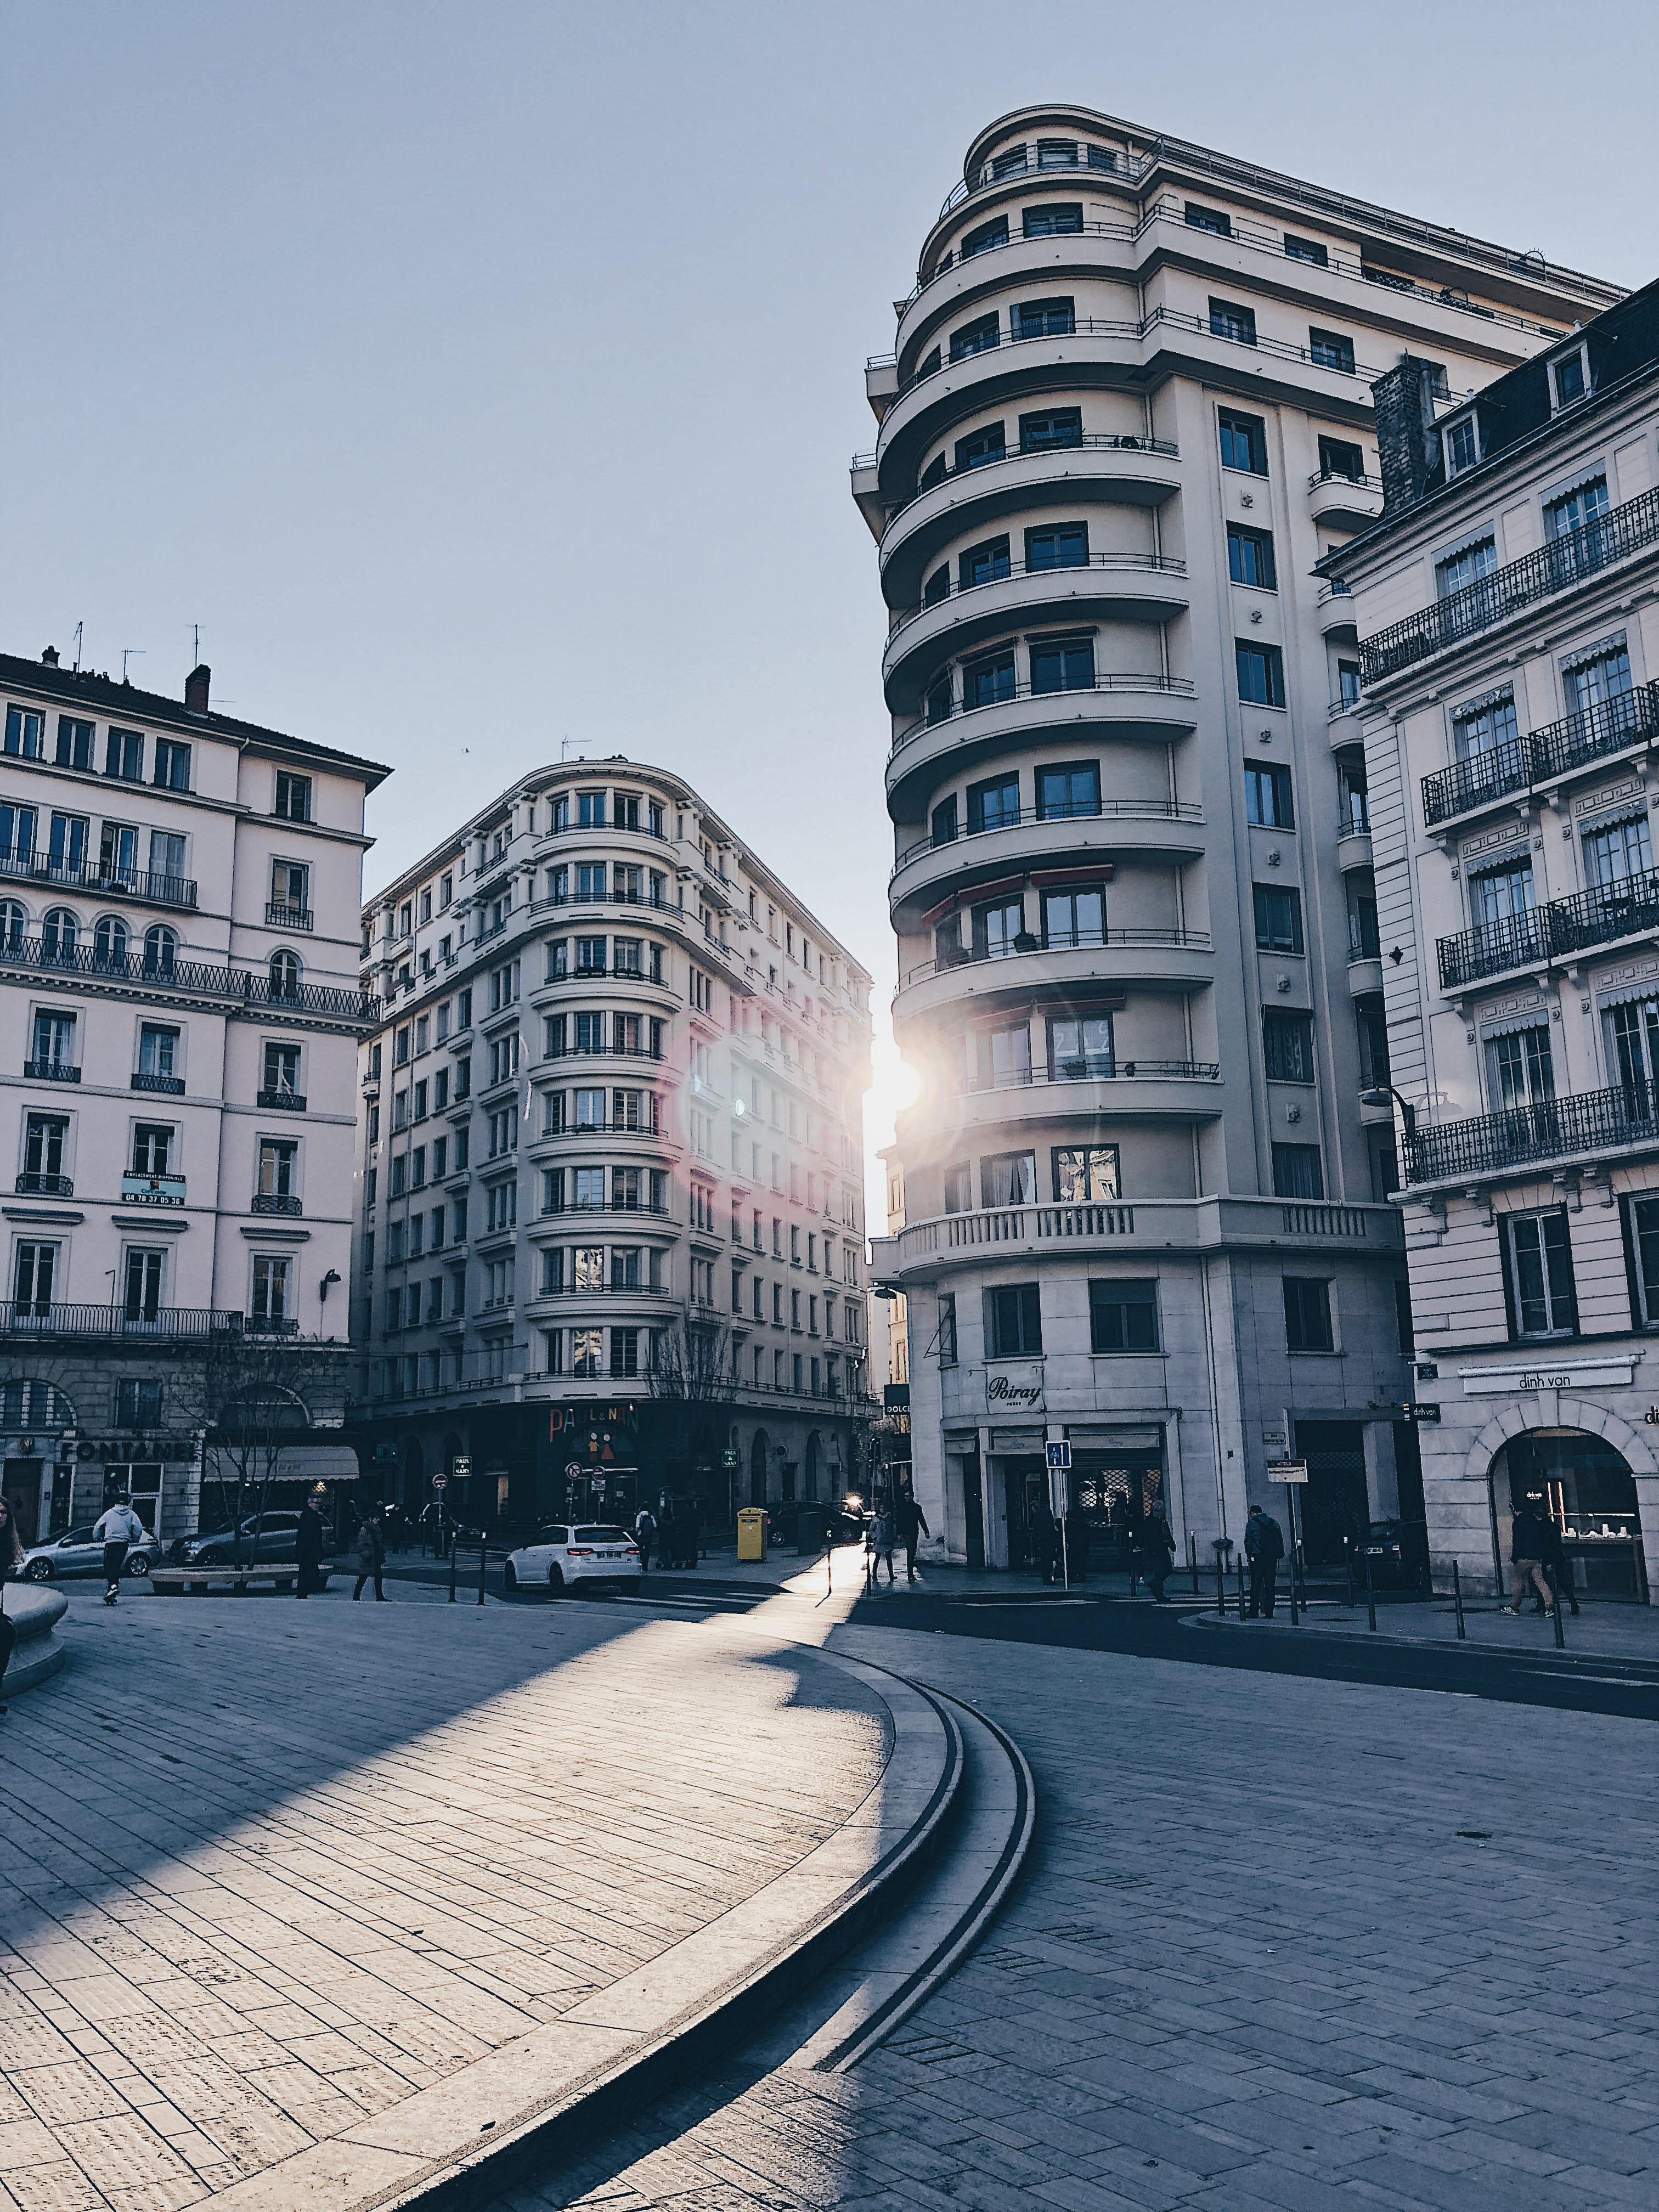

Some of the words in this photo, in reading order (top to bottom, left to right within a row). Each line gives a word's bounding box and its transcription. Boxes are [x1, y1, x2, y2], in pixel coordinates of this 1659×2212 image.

[989, 1376, 1042, 1406] Poiray
[1519, 1373, 1544, 1389] dinh
[1548, 1376, 1571, 1387] van
[1414, 1407, 1425, 1415] dinh
[549, 1408, 597, 1443] PAUL
